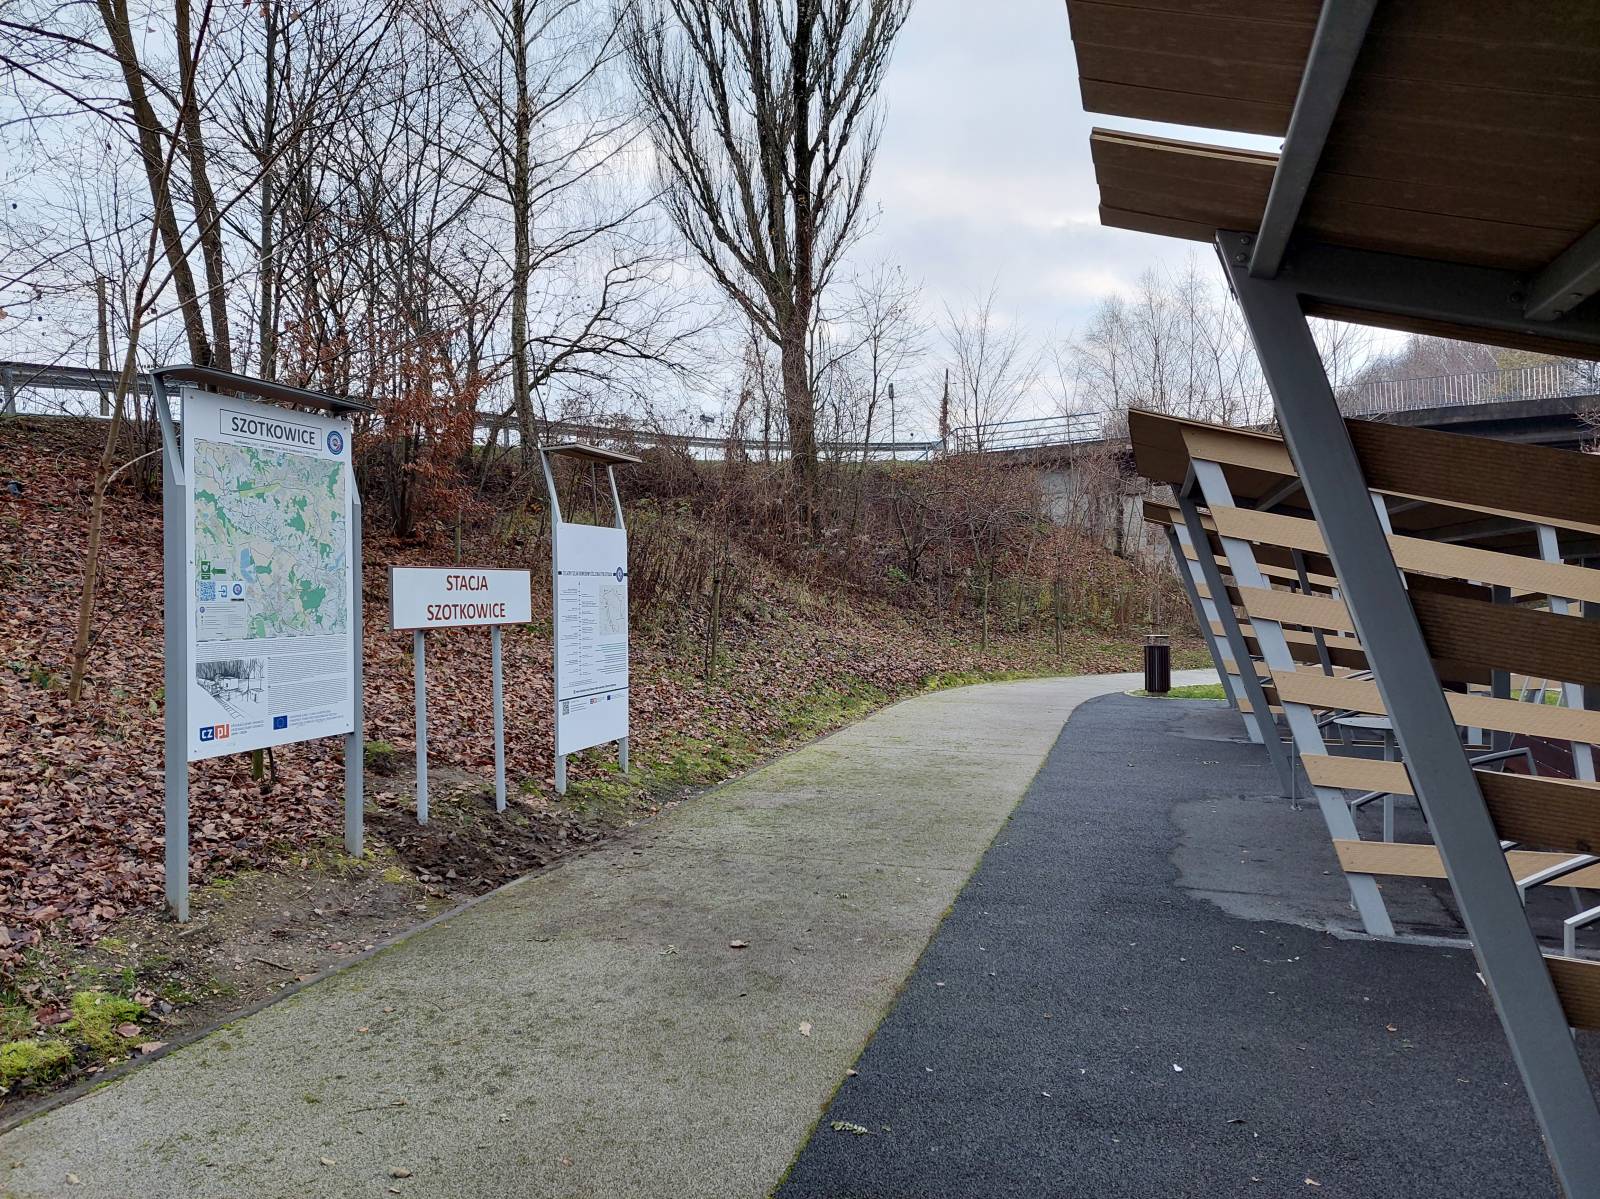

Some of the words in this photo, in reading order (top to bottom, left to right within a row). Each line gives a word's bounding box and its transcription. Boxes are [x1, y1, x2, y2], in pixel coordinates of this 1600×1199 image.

[231, 416, 316, 445] SZOTKOWICE
[446, 575, 488, 591] STACJA
[426, 603, 506, 620] SZOTKOWICE
